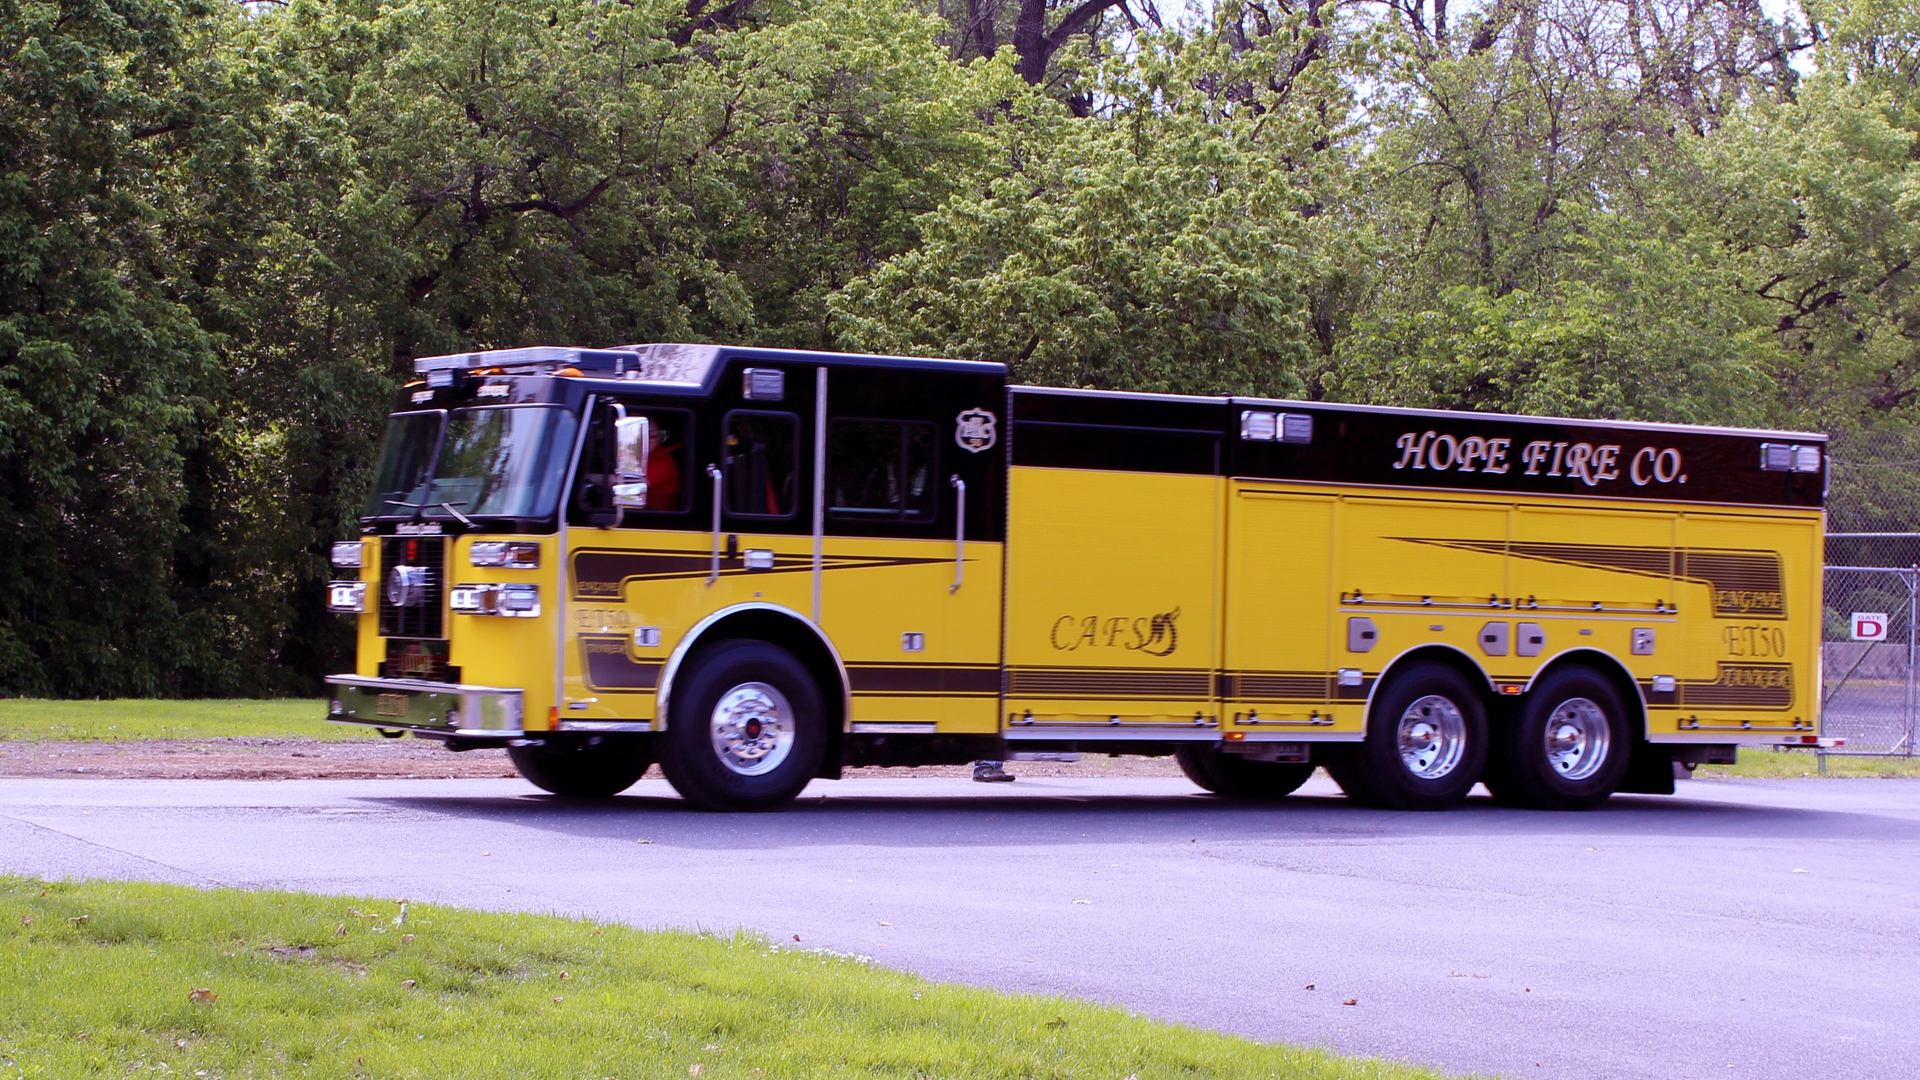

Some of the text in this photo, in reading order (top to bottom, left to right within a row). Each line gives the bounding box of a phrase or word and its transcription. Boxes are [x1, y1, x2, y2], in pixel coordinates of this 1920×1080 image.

[1392, 430, 1688, 486] HOPE FIRE CO.
[1715, 590, 1782, 612] ENGINE
[1050, 615, 1149, 651] CAFS
[1721, 624, 1786, 658] ET50
[1857, 620, 1882, 638] D
